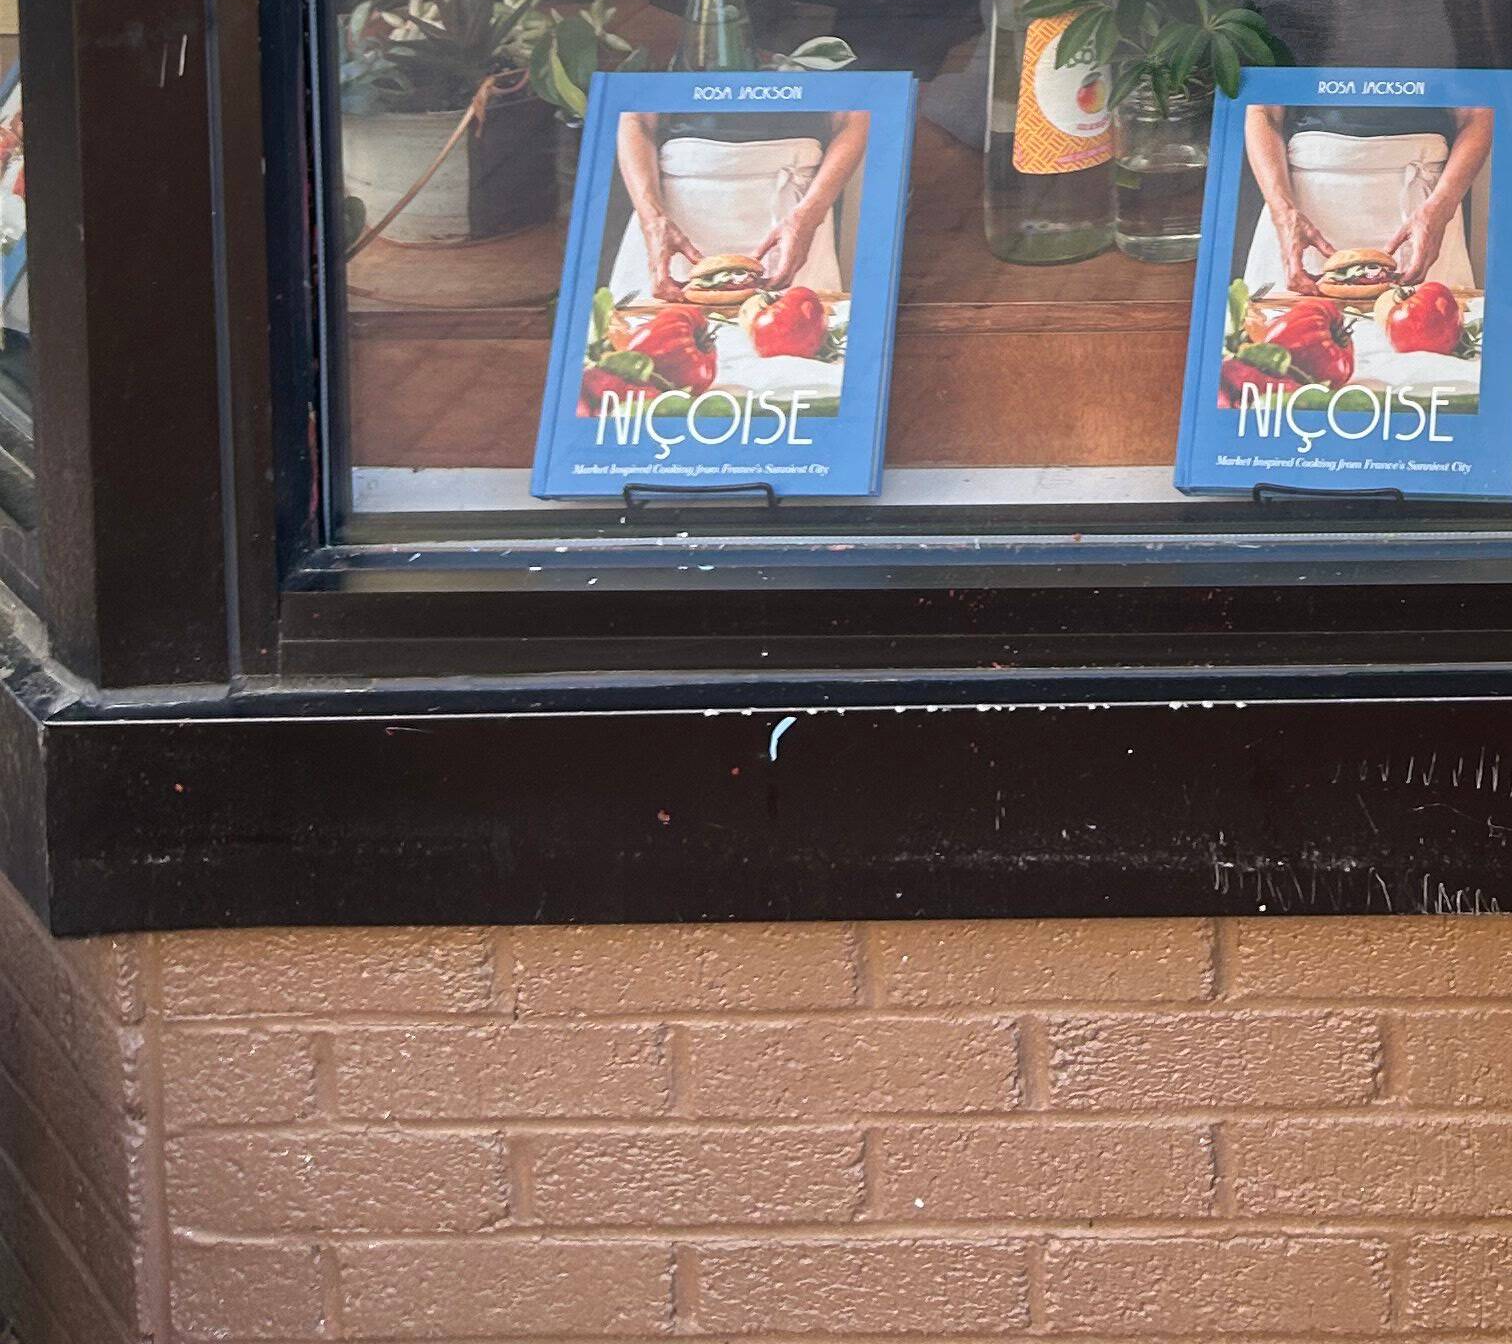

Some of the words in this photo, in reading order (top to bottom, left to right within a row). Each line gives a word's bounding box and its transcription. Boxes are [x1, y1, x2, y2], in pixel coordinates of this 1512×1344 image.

[694, 86, 732, 100] ROSA
[738, 86, 803, 100] JACKSON
[1318, 81, 1356, 96] ROSA
[1362, 81, 1426, 96] JACKSON
[596, 389, 818, 460] NIÇOISE
[1237, 381, 1455, 454] NIÇOISE
[1336, 458, 1362, 471] from
[1451, 461, 1472, 475] City
